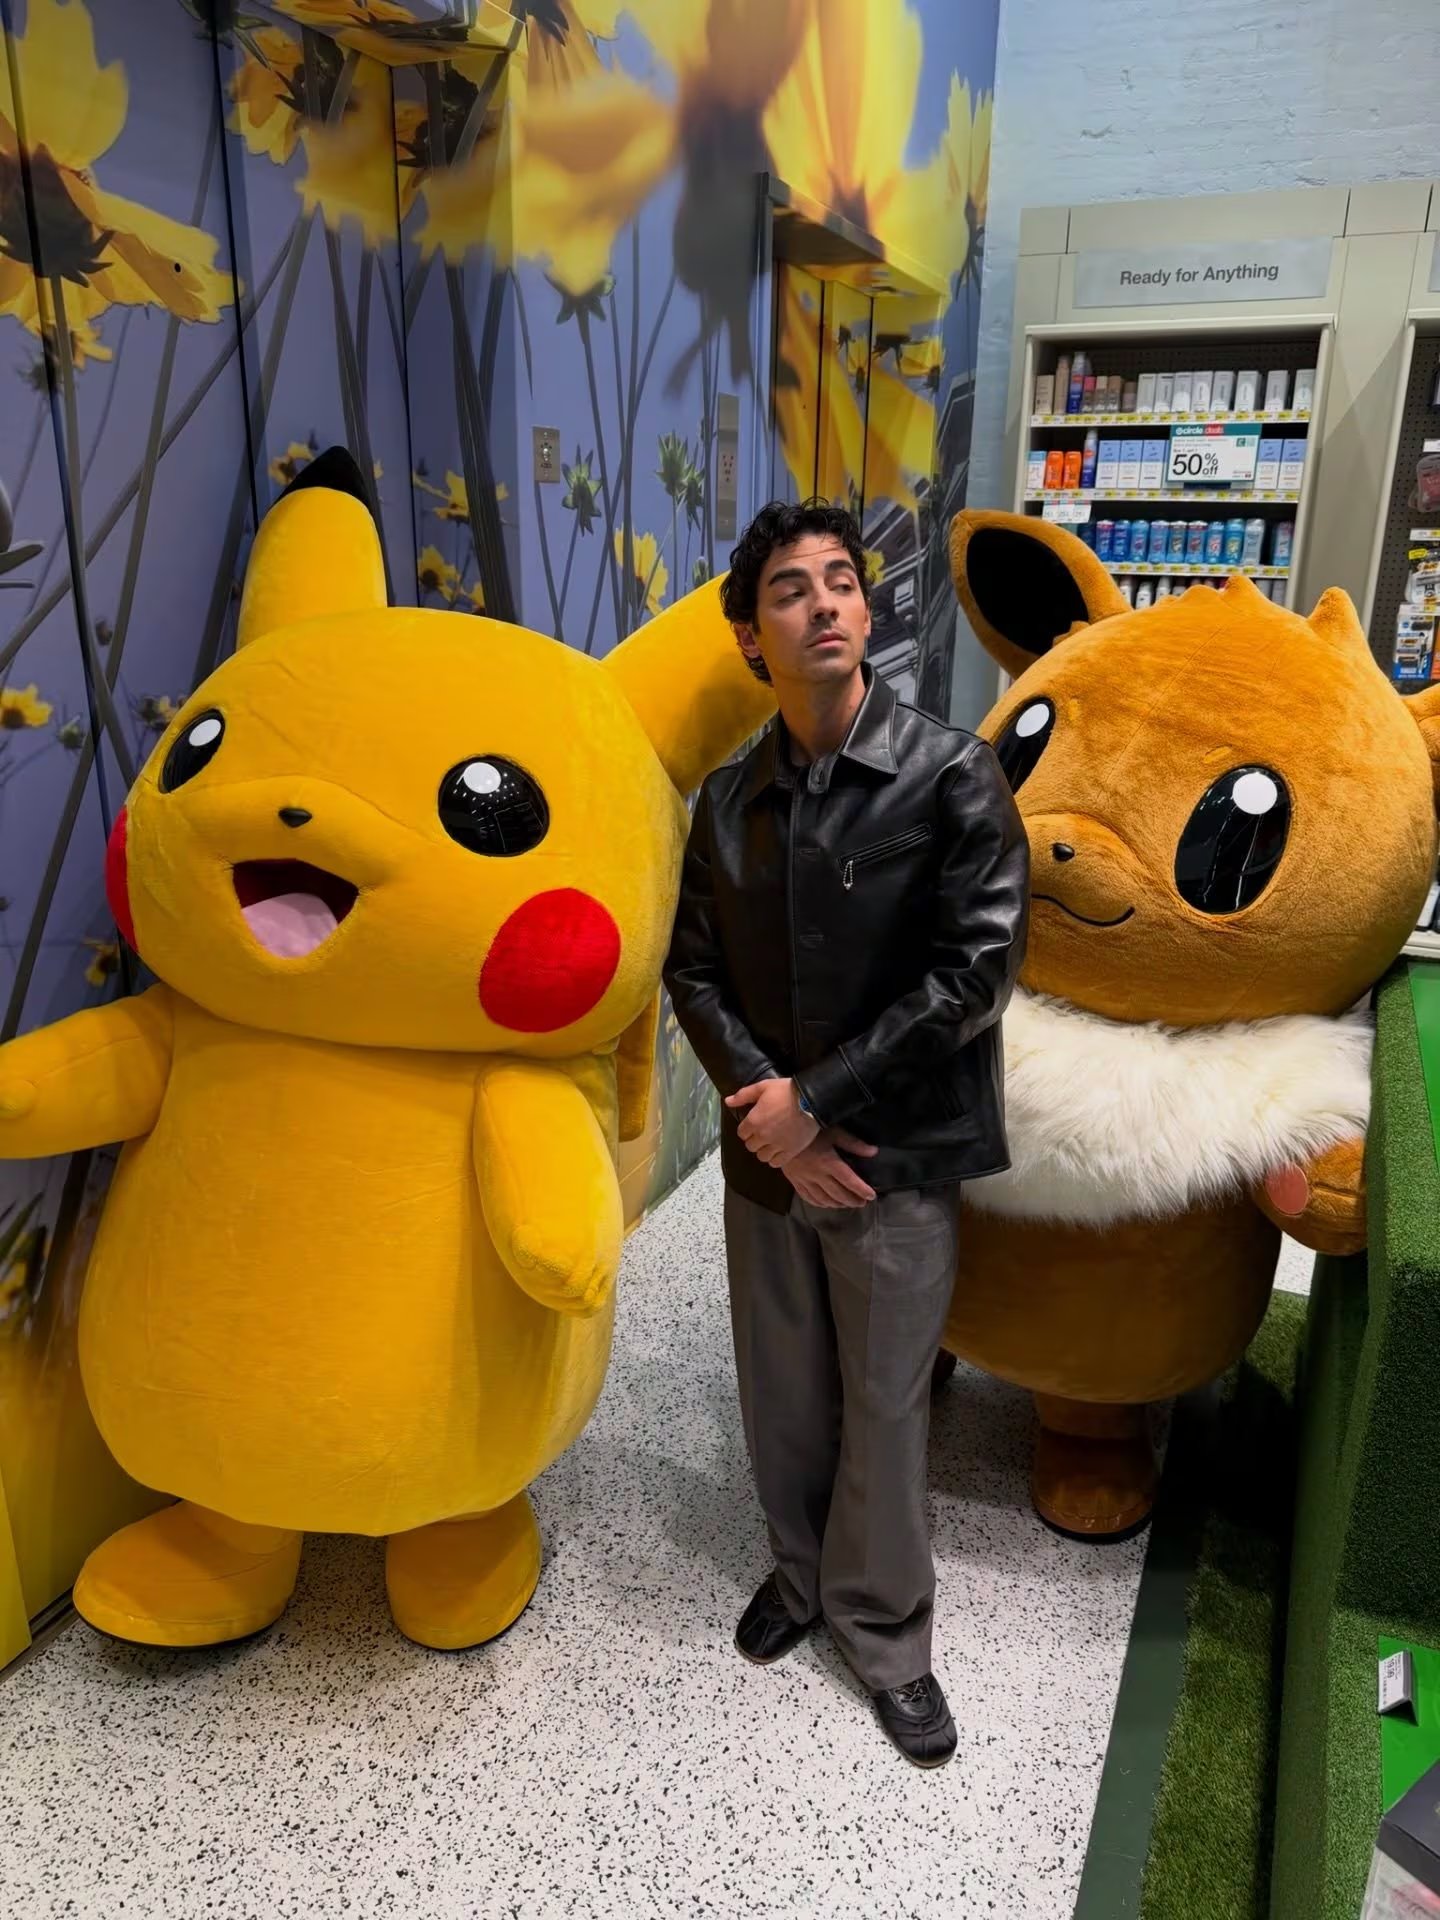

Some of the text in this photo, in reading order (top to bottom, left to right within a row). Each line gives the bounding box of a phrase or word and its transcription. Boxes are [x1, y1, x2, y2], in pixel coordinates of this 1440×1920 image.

[1120, 264, 1279, 286] Ready for Anything
[1183, 426, 1203, 434] circle
[1202, 465, 1219, 475] off
